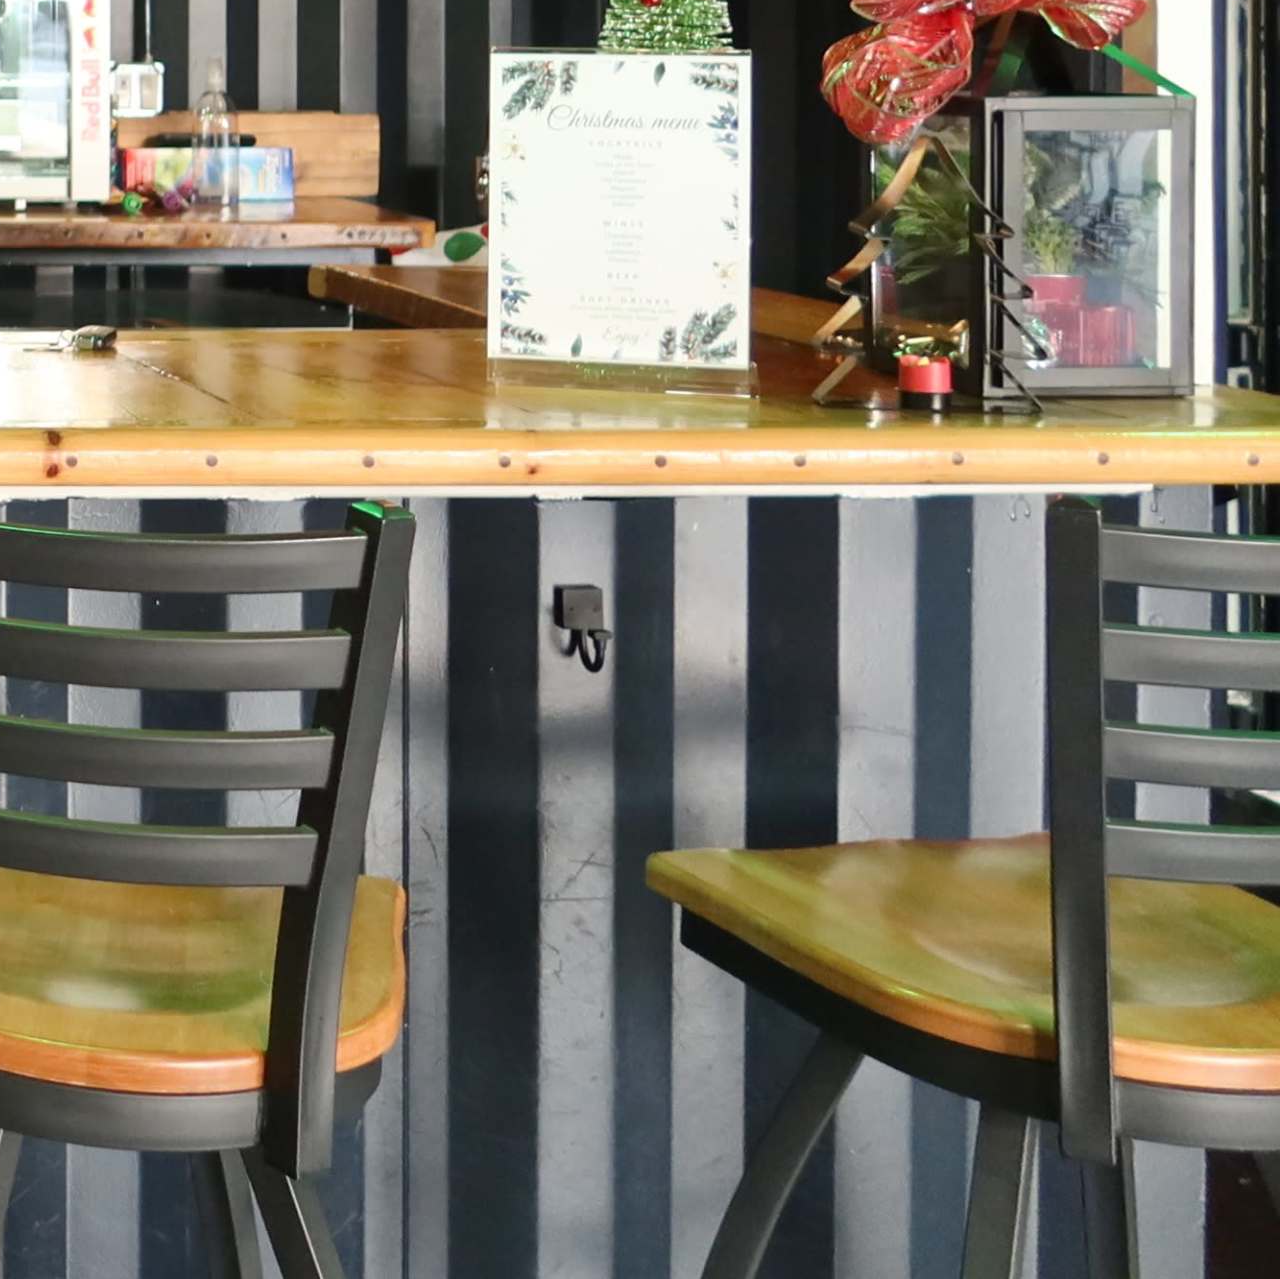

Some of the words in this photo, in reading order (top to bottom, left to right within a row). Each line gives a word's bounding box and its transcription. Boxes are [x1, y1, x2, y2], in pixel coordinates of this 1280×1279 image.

[81, 59, 101, 97] Bull
[81, 102, 101, 142] Red
[546, 104, 644, 131] Christmas
[651, 117, 701, 130] menu
